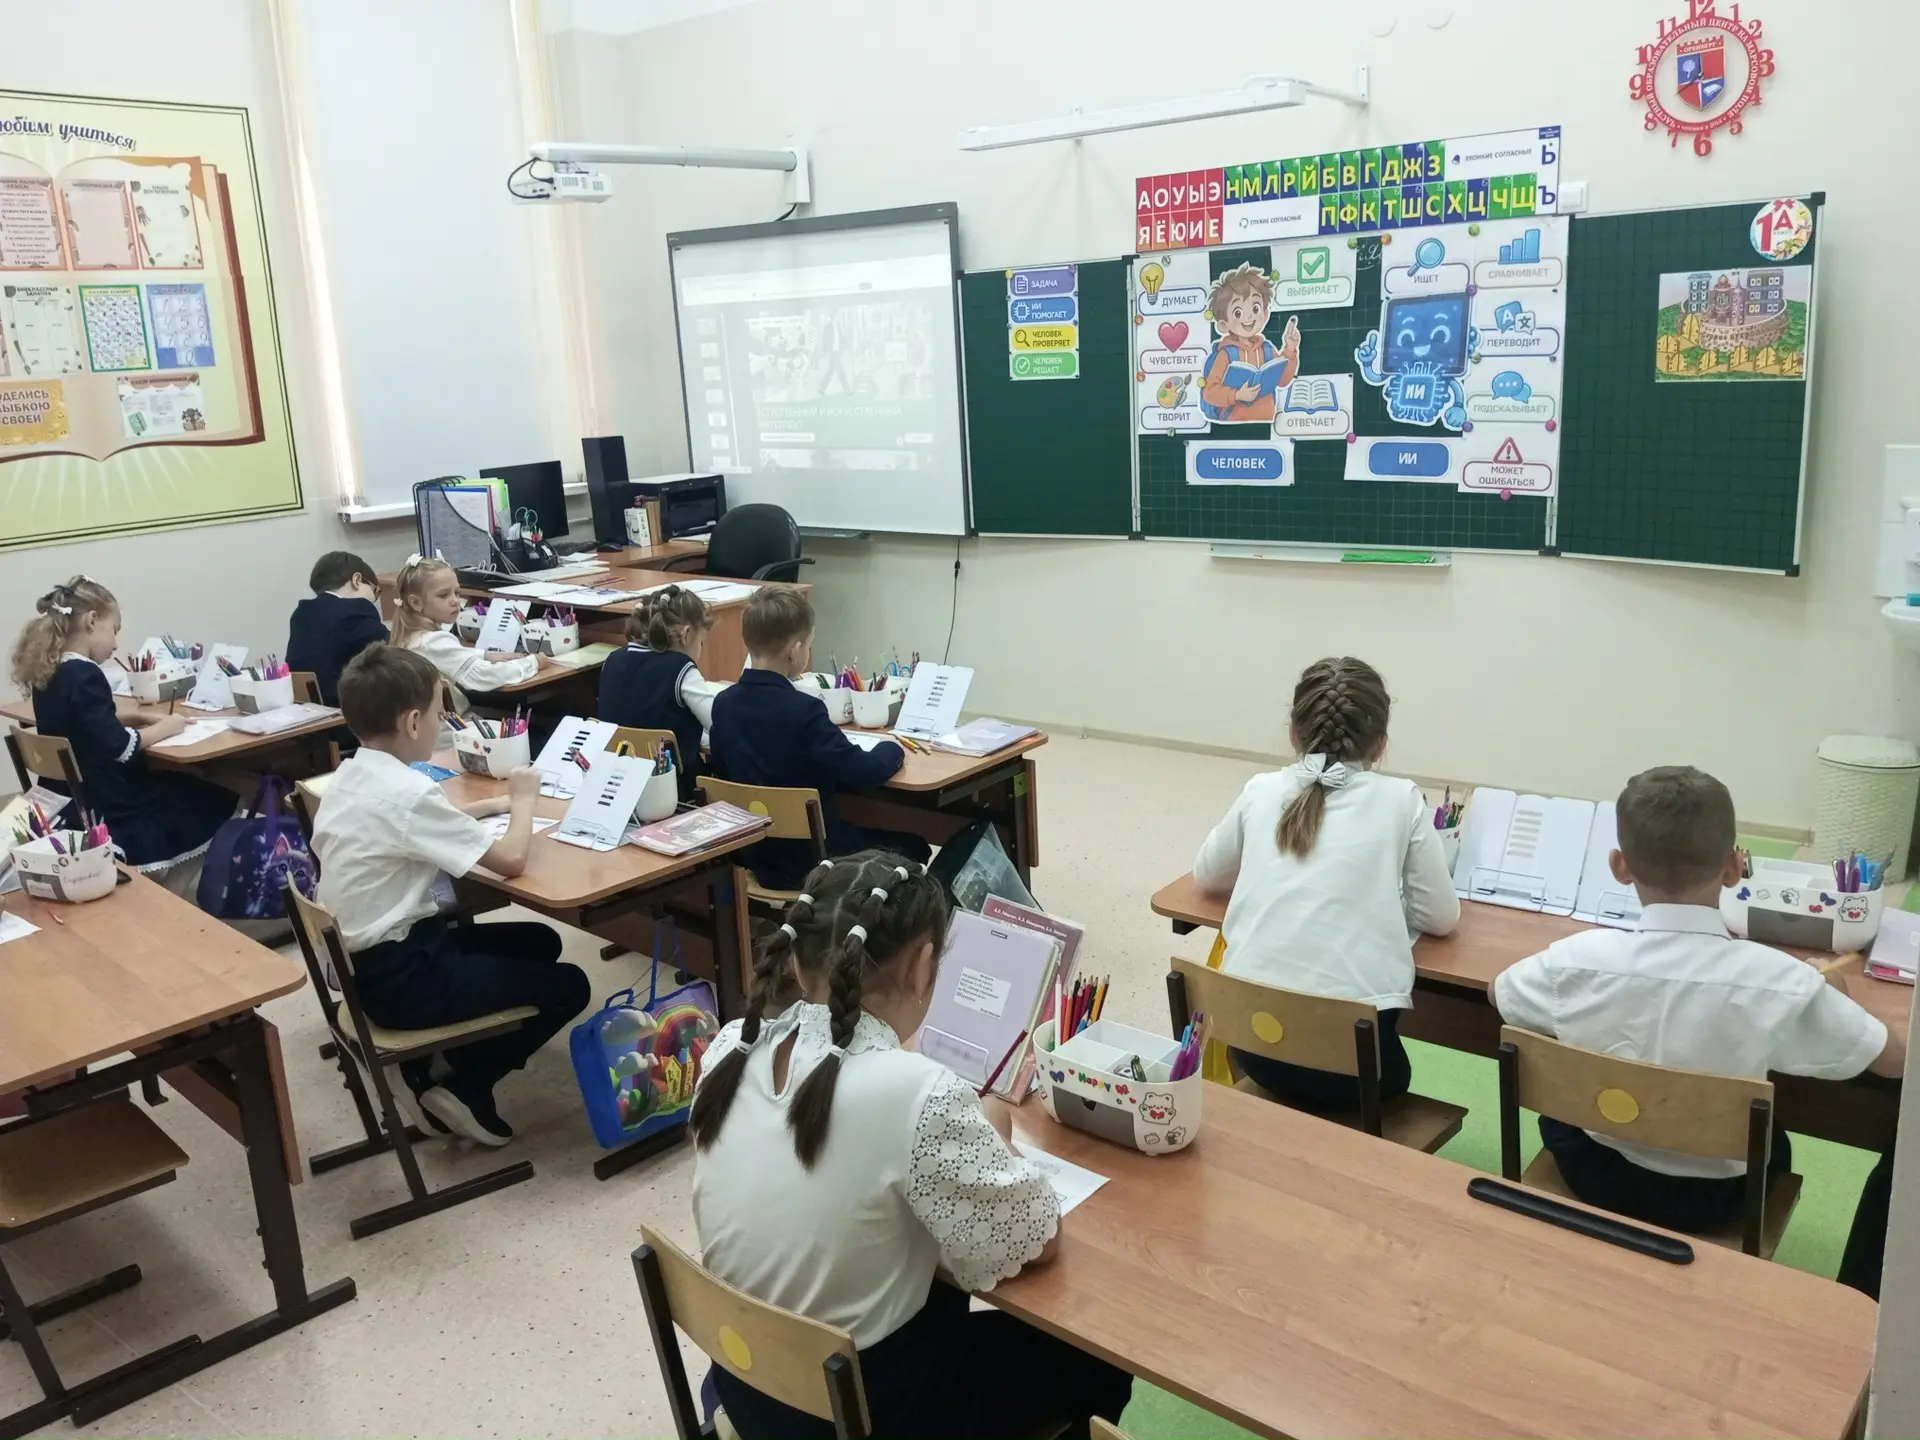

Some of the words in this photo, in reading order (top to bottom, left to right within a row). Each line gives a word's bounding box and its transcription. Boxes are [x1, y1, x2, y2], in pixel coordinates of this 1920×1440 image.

[1684, 0, 1716, 19] 12
[1730, 3, 1742, 23] 1
[1656, 17, 1679, 39] 11
[1708, 17, 1739, 32] ЦЕНТР
[1748, 19, 1762, 39] 2
[1738, 29, 1749, 42] НА
[1759, 49, 1775, 77] 3
[1629, 74, 1646, 100] 9
[1727, 94, 1750, 119] ПОЛЕ
[1644, 112, 1658, 130] 8
[59, 123, 135, 150] учиться
[1693, 130, 1712, 156] 6
[1465, 152, 1493, 161] ЗВОНКИЕ
[1494, 149, 1533, 158] СОГЛАСНЫЕ
[1541, 144, 1556, 165] Ь
[1138, 191, 1151, 210] А
[1154, 188, 1169, 207] О
[1172, 185, 1185, 205] У
[1189, 183, 1204, 204] Ы
[1208, 181, 1221, 201] Э
[1226, 180, 1240, 199] Н
[1243, 177, 1260, 198] М
[1263, 174, 1279, 195] Л
[1283, 172, 1296, 193] Р
[1302, 164, 1317, 190] Й
[1322, 167, 1336, 188] Б
[1343, 165, 1356, 186] В
[1365, 162, 1376, 183] Г
[1381, 160, 1400, 186] Д
[1402, 157, 1422, 179] Ж
[1427, 154, 1440, 176] З
[1538, 185, 1556, 205] Ъ
[1321, 206, 1336, 227] П
[1340, 203, 1358, 224] Ф
[1362, 201, 1376, 222] К
[1383, 199, 1397, 220] Т
[1402, 196, 1421, 219] Ш
[1425, 195, 1440, 217] С
[1447, 192, 1463, 214] Х
[1468, 190, 1486, 216] Ц
[1492, 188, 1508, 210] Ч
[1513, 185, 1535, 212] Щ
[1250, 218, 1269, 226] ГЛУХИЕ
[1270, 214, 1302, 224] СОГЛАСНЫЕ
[1139, 226, 1150, 245] Я
[1156, 220, 1167, 243] Ё
[1171, 222, 1187, 241] Ю
[1189, 220, 1203, 239] И
[1209, 218, 1220, 238] Е
[1414, 275, 1438, 284] ИЩЕТ
[1488, 268, 1549, 279] СРАВНИВАЕТ
[1031, 280, 1058, 288] ЗАДАЧА
[1287, 285, 1338, 297] ВЫБИРАЕТ
[1161, 296, 1198, 307] ДУМАЕТ
[1032, 311, 1067, 319] ПОМОГАЕТ
[1487, 338, 1541, 348] ПЕРЕВОДИТ
[1033, 356, 1063, 364] ЧЕЛОВЕК
[1149, 355, 1198, 366] ЧУВСТВУЕТ
[1033, 366, 1059, 374] РЕШАЕТ
[1405, 383, 1426, 400] ИИ
[1473, 404, 1547, 414] ПОДСКАЗЫВАЕТ
[1157, 412, 1191, 422] ТВОРИТ
[1287, 417, 1335, 428] ОТВЕЧАЕТ
[1211, 457, 1266, 470] ЧЕЛОВЕК
[1398, 452, 1417, 465] ИИ
[1490, 466, 1524, 476] МОЖЕТ
[1478, 476, 1535, 487] ОШИБАТЬСЯ
